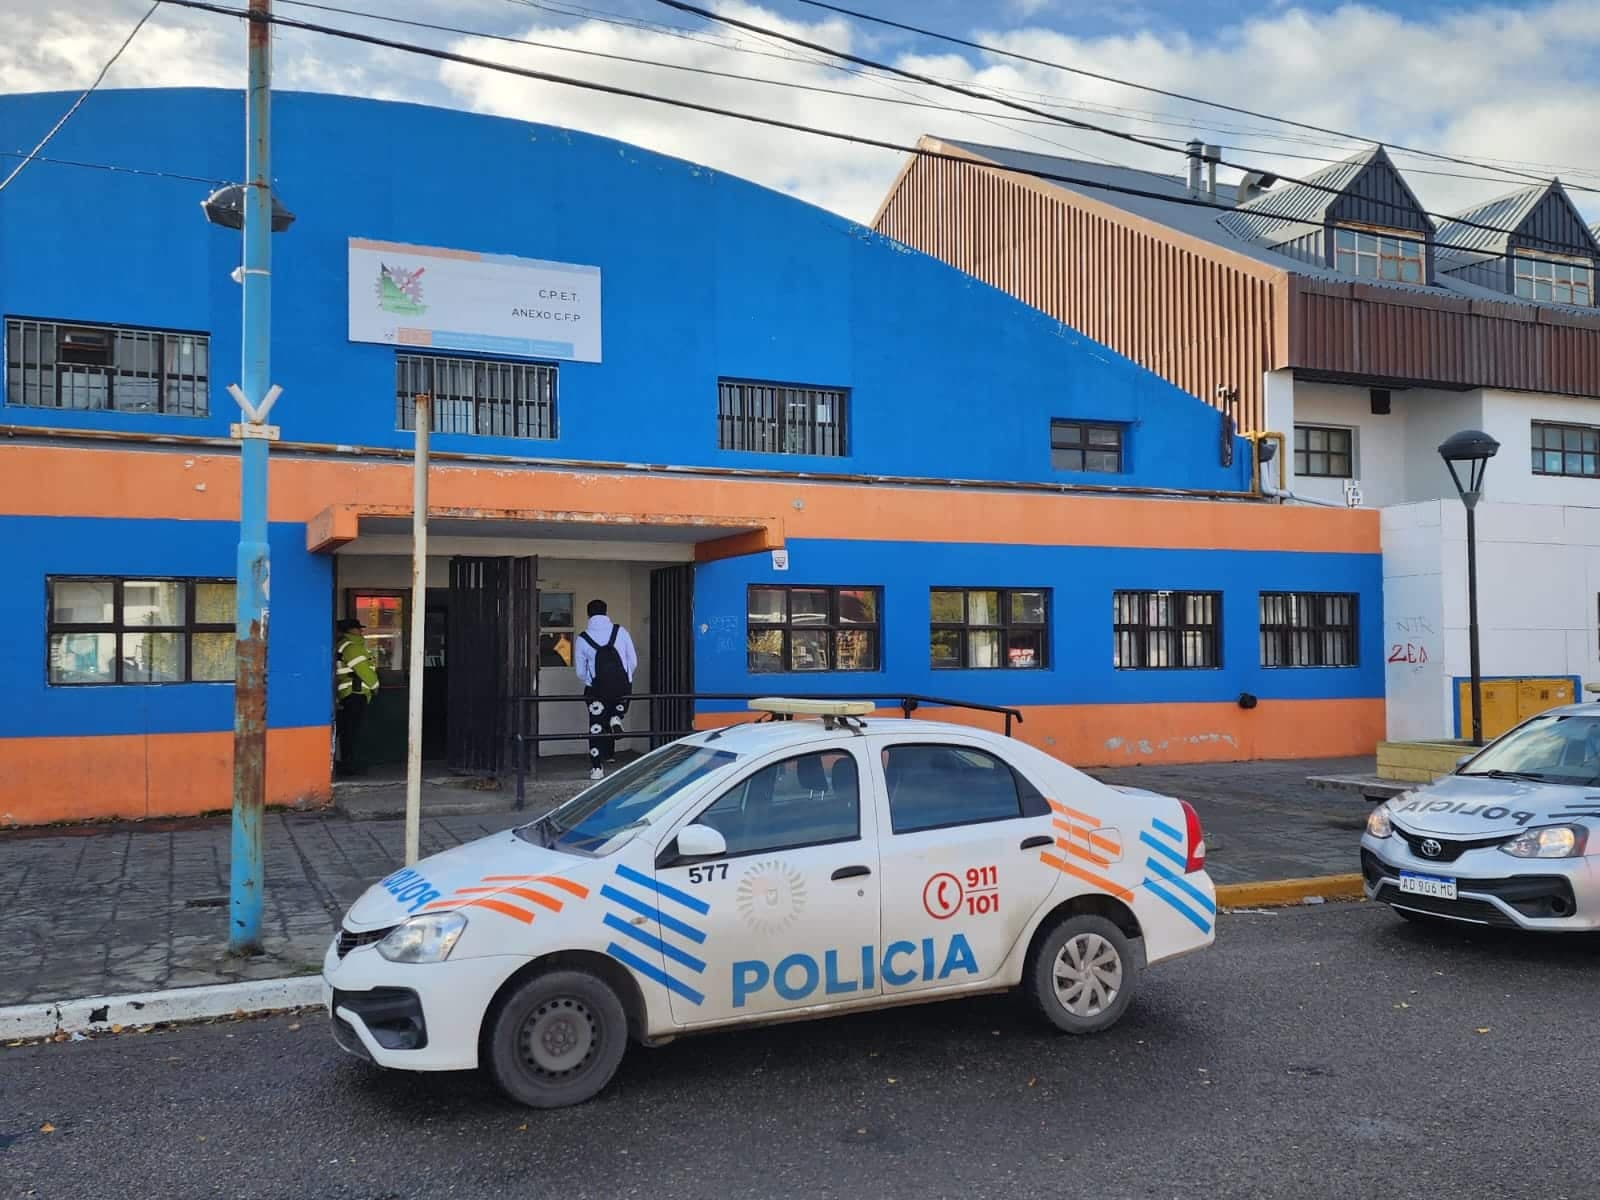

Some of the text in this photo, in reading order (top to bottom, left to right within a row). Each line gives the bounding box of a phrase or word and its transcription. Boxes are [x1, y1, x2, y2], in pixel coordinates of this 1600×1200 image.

[511, 307, 551, 320] ANEXO
[689, 863, 729, 884] 577
[966, 865, 998, 888] 911
[966, 894, 999, 915] 101
[732, 933, 979, 1008] POLICIA
